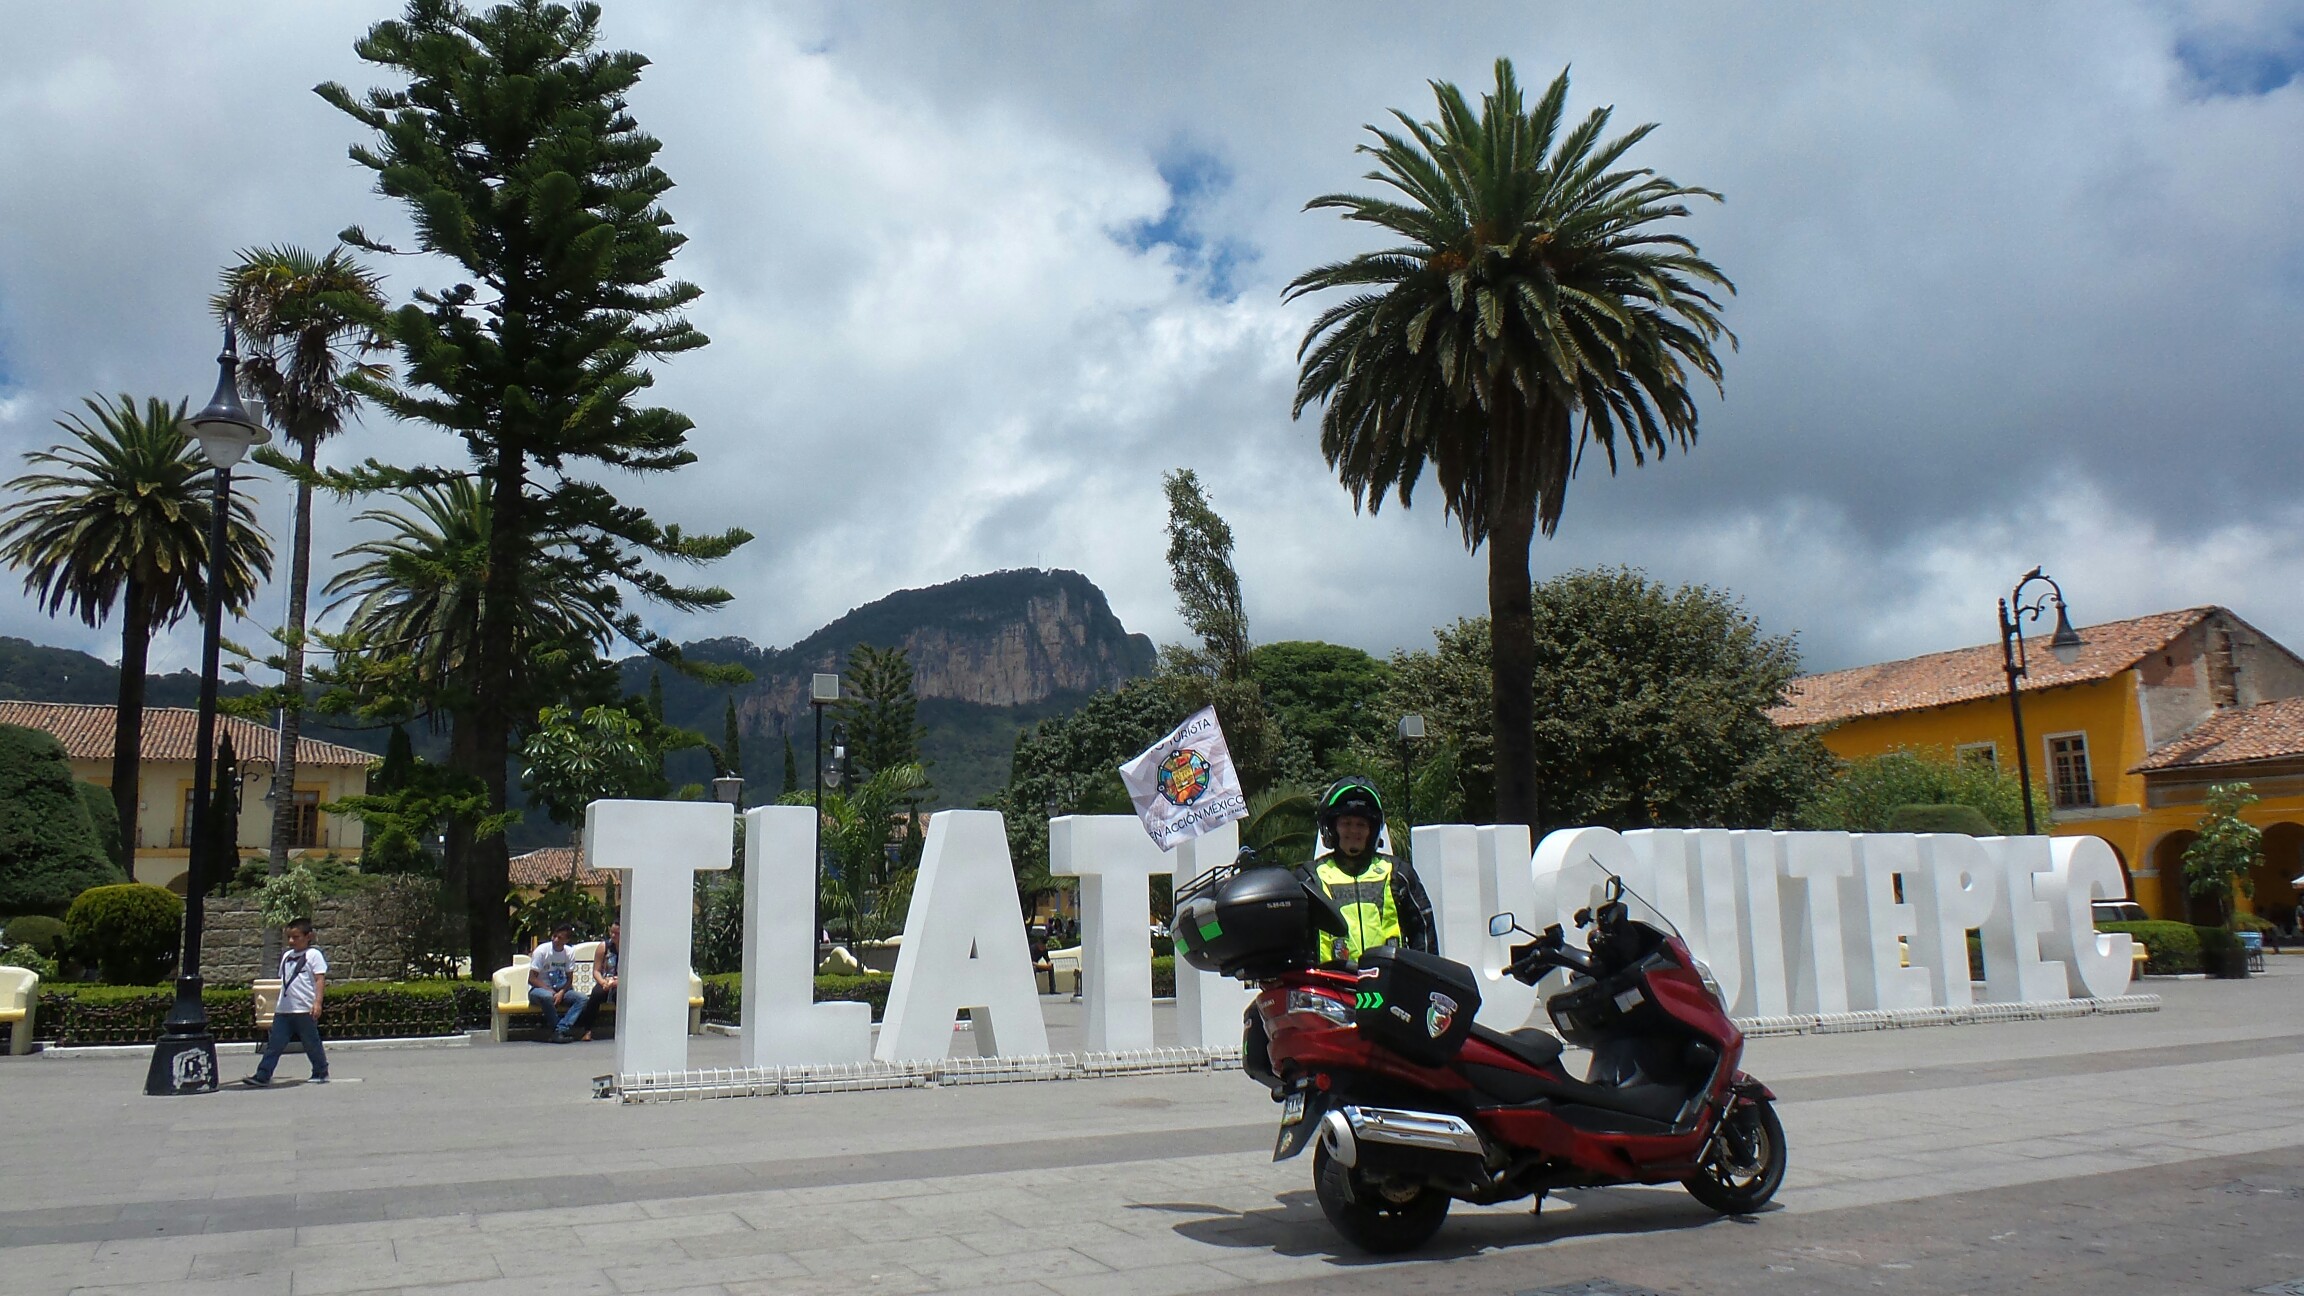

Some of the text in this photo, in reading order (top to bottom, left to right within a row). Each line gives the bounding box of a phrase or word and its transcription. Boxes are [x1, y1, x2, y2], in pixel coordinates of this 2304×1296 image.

[1165, 811, 1203, 837] ACCIÓN
[1203, 795, 1245, 818] MÉXICO
[585, 799, 2133, 1076] TLATLUQUITEPEC
